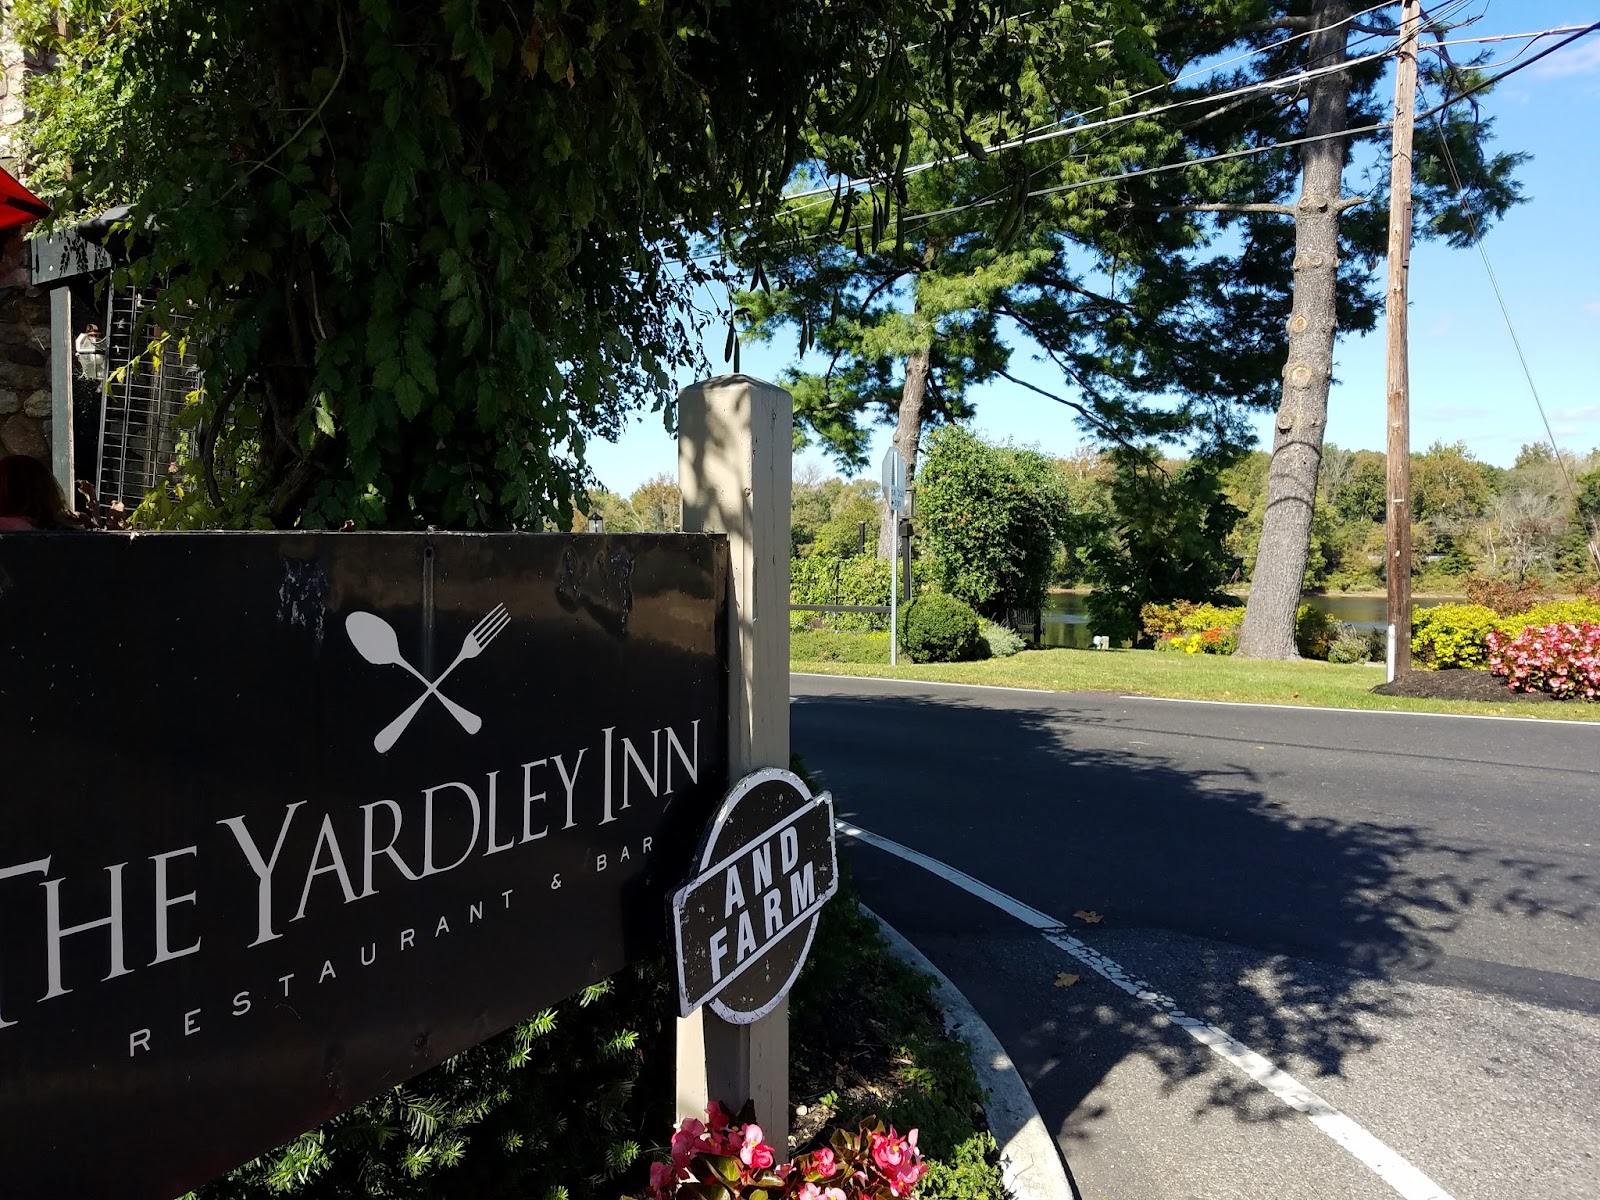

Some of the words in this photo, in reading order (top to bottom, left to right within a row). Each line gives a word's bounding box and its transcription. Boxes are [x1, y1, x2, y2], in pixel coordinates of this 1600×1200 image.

[216, 747, 588, 948] YARDLEY
[598, 719, 700, 825] INN
[724, 826, 799, 919] AND
[129, 890, 513, 1057] RESTAURANT
[550, 873, 562, 890] &
[596, 836, 653, 872] BAR
[710, 861, 816, 984] FARM
